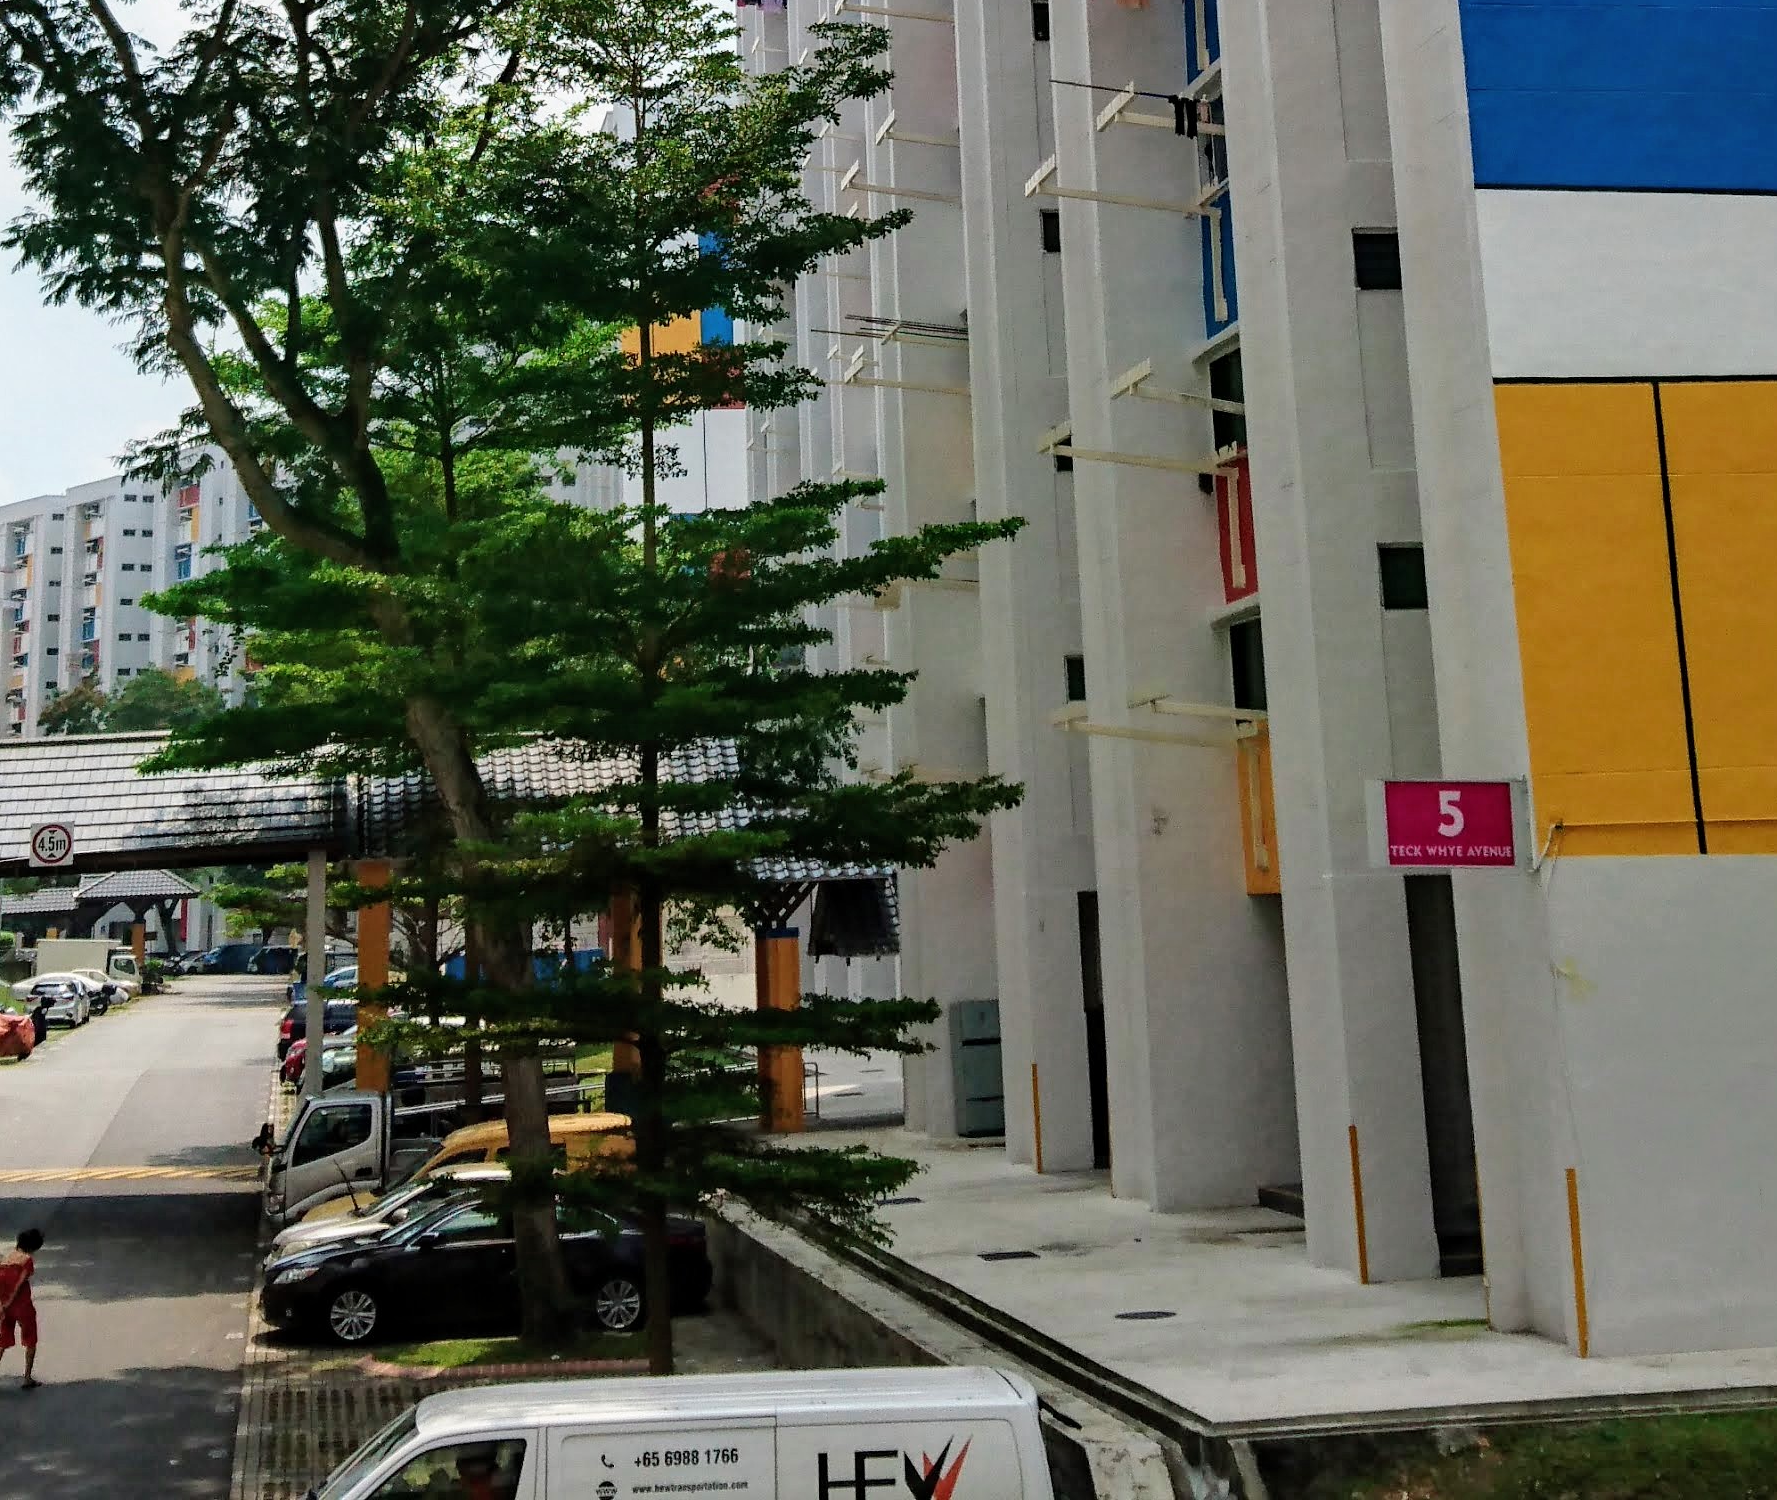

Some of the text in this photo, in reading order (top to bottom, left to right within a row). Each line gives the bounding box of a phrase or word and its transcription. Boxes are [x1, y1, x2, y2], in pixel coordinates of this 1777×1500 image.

[1438, 790, 1465, 837] 5
[38, 836, 67, 852] 4.5m
[1390, 845, 1513, 858] TECK WHYE AVENUE
[634, 1447, 739, 1468] +65 6988 1766
